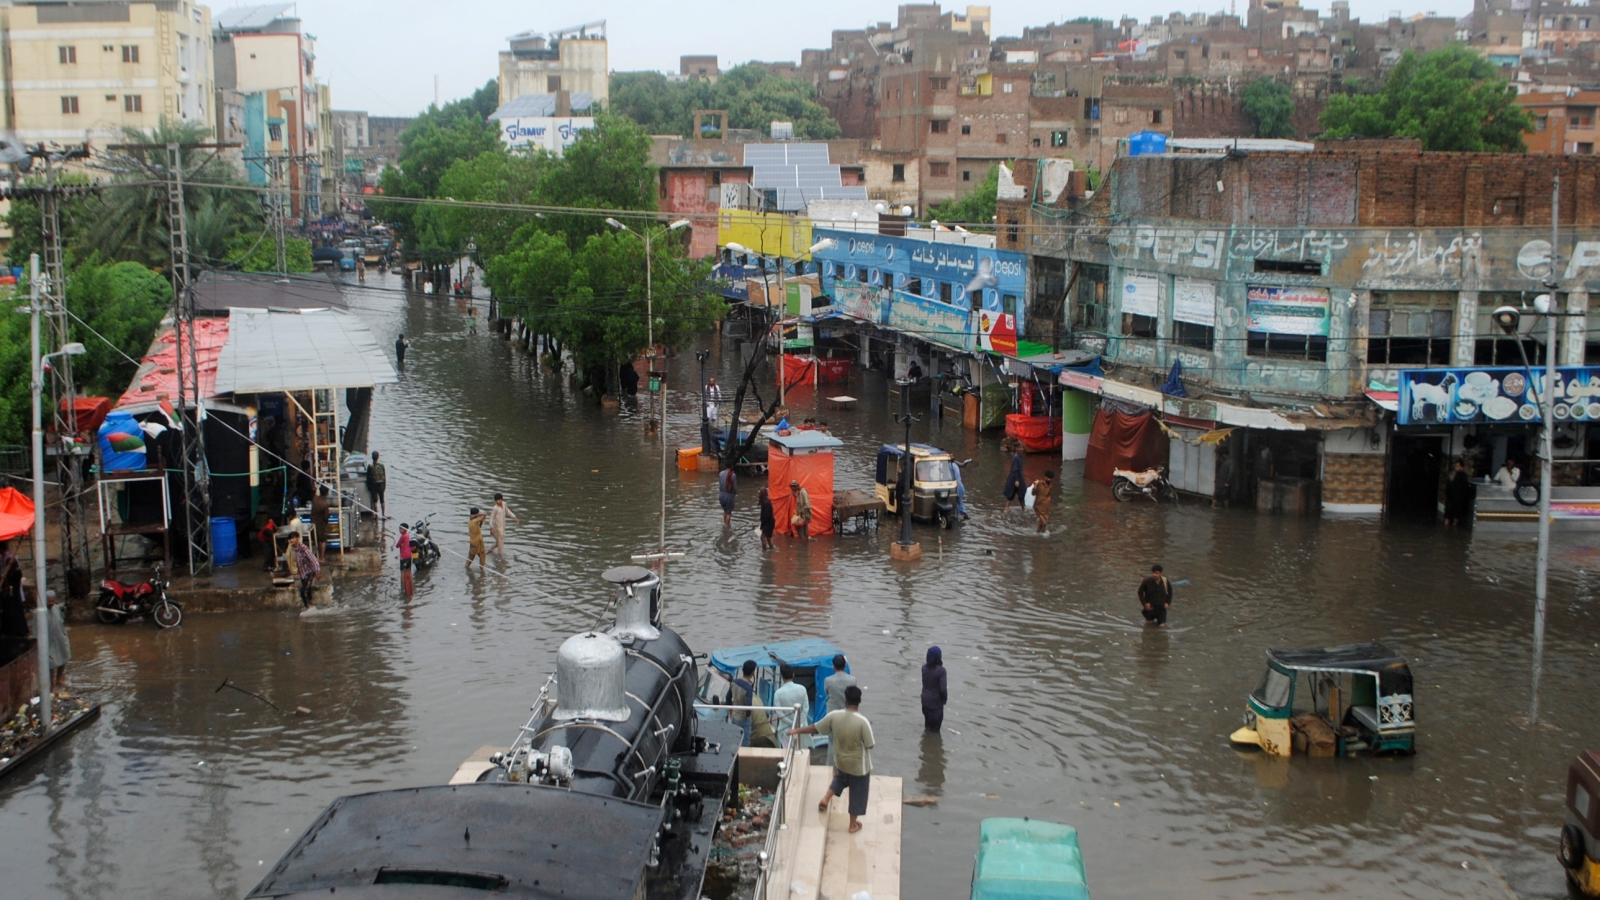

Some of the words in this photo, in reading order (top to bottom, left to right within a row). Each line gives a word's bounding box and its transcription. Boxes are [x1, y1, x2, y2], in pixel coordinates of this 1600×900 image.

[856, 240, 875, 256] pepsi
[1132, 224, 1226, 270] PEPSI
[994, 258, 1022, 277] pepsi
[1213, 295, 1225, 359] PEPSI
[1329, 295, 1345, 354] PEPSI
[1457, 296, 1476, 364] PEPSI
[1178, 351, 1210, 370] PEPSI
[1259, 364, 1321, 382] PEPSI
[1513, 378, 1524, 386] 24
